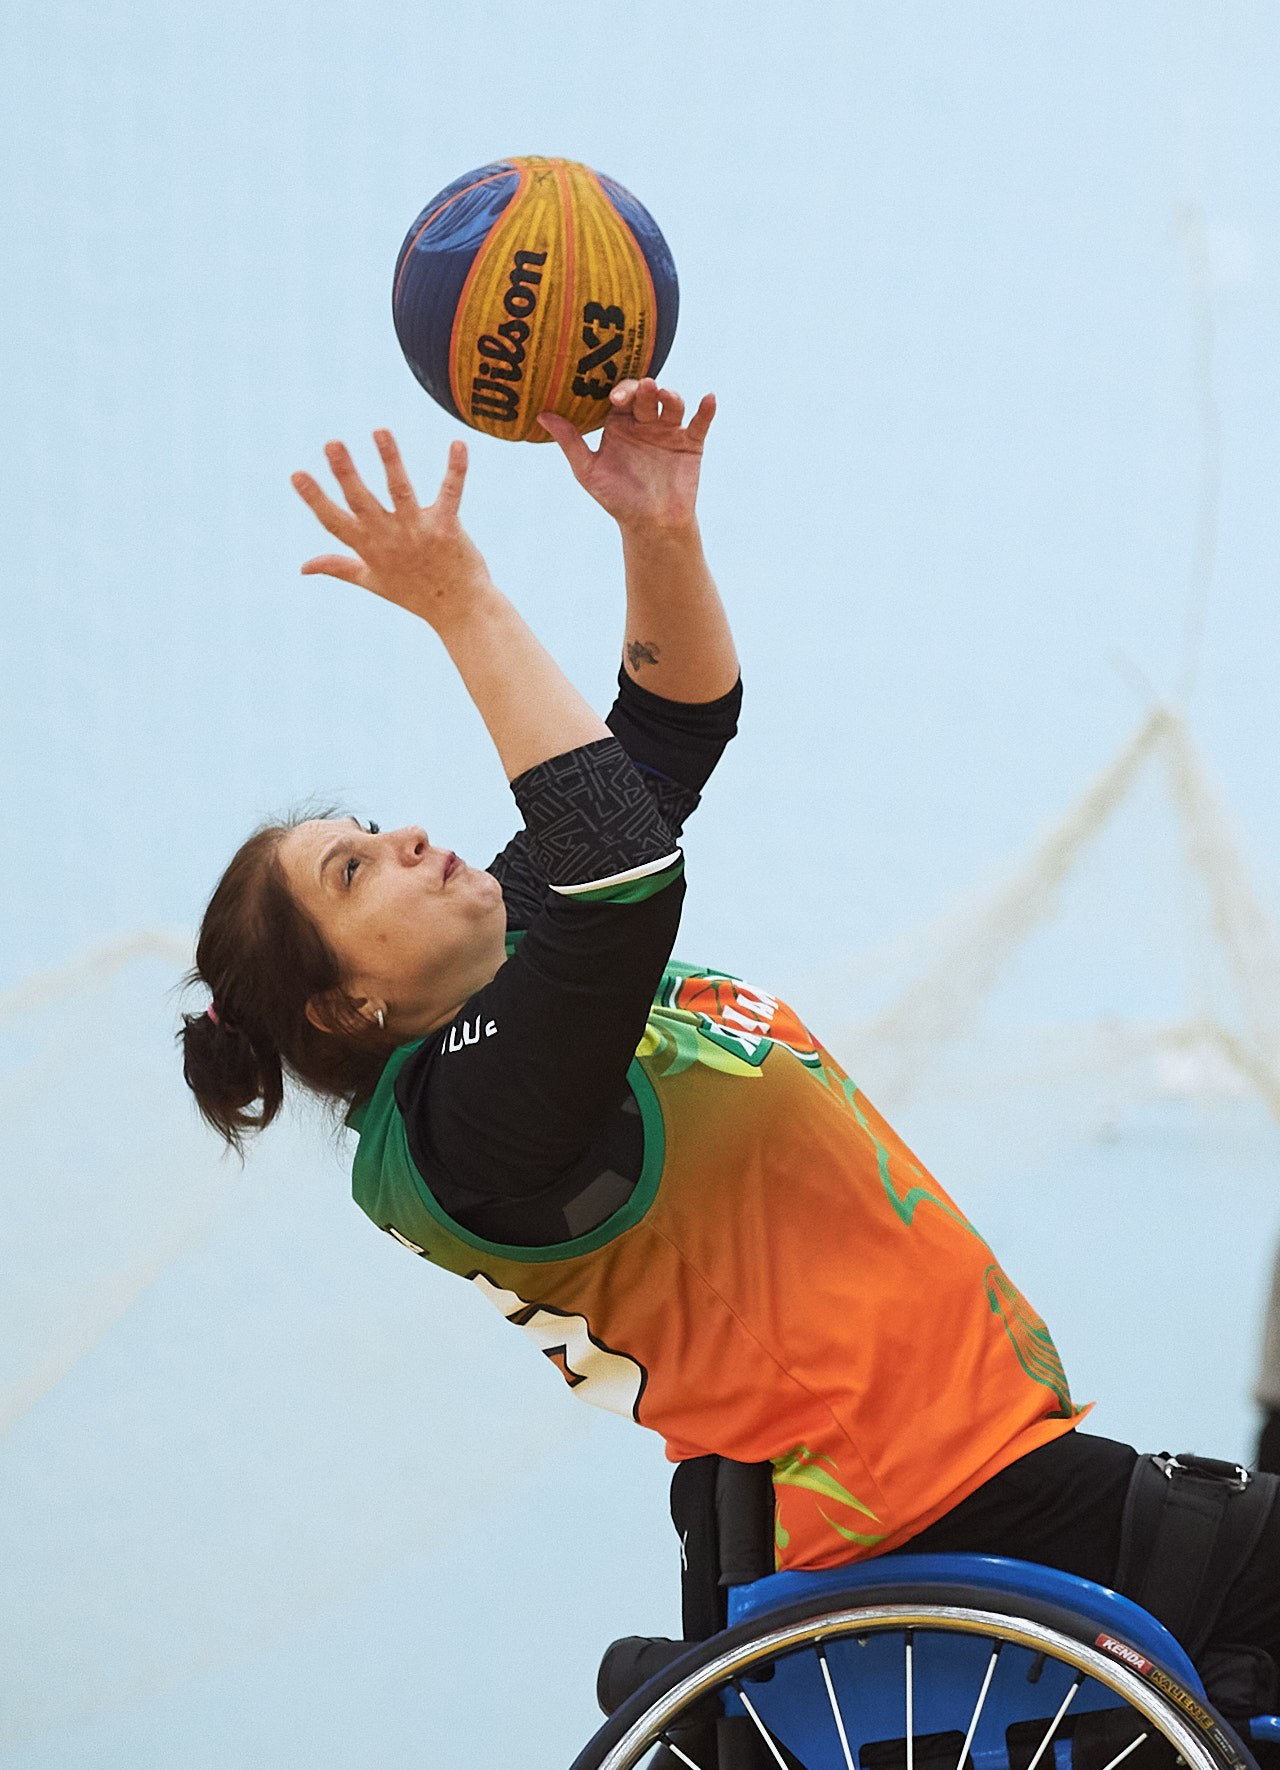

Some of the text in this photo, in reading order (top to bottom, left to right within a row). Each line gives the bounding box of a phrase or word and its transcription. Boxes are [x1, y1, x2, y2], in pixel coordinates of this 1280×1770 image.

[471, 250, 548, 423] Wilson
[1102, 1639, 1145, 1669] KENDA
[1151, 1669, 1214, 1729] KALIENTE
